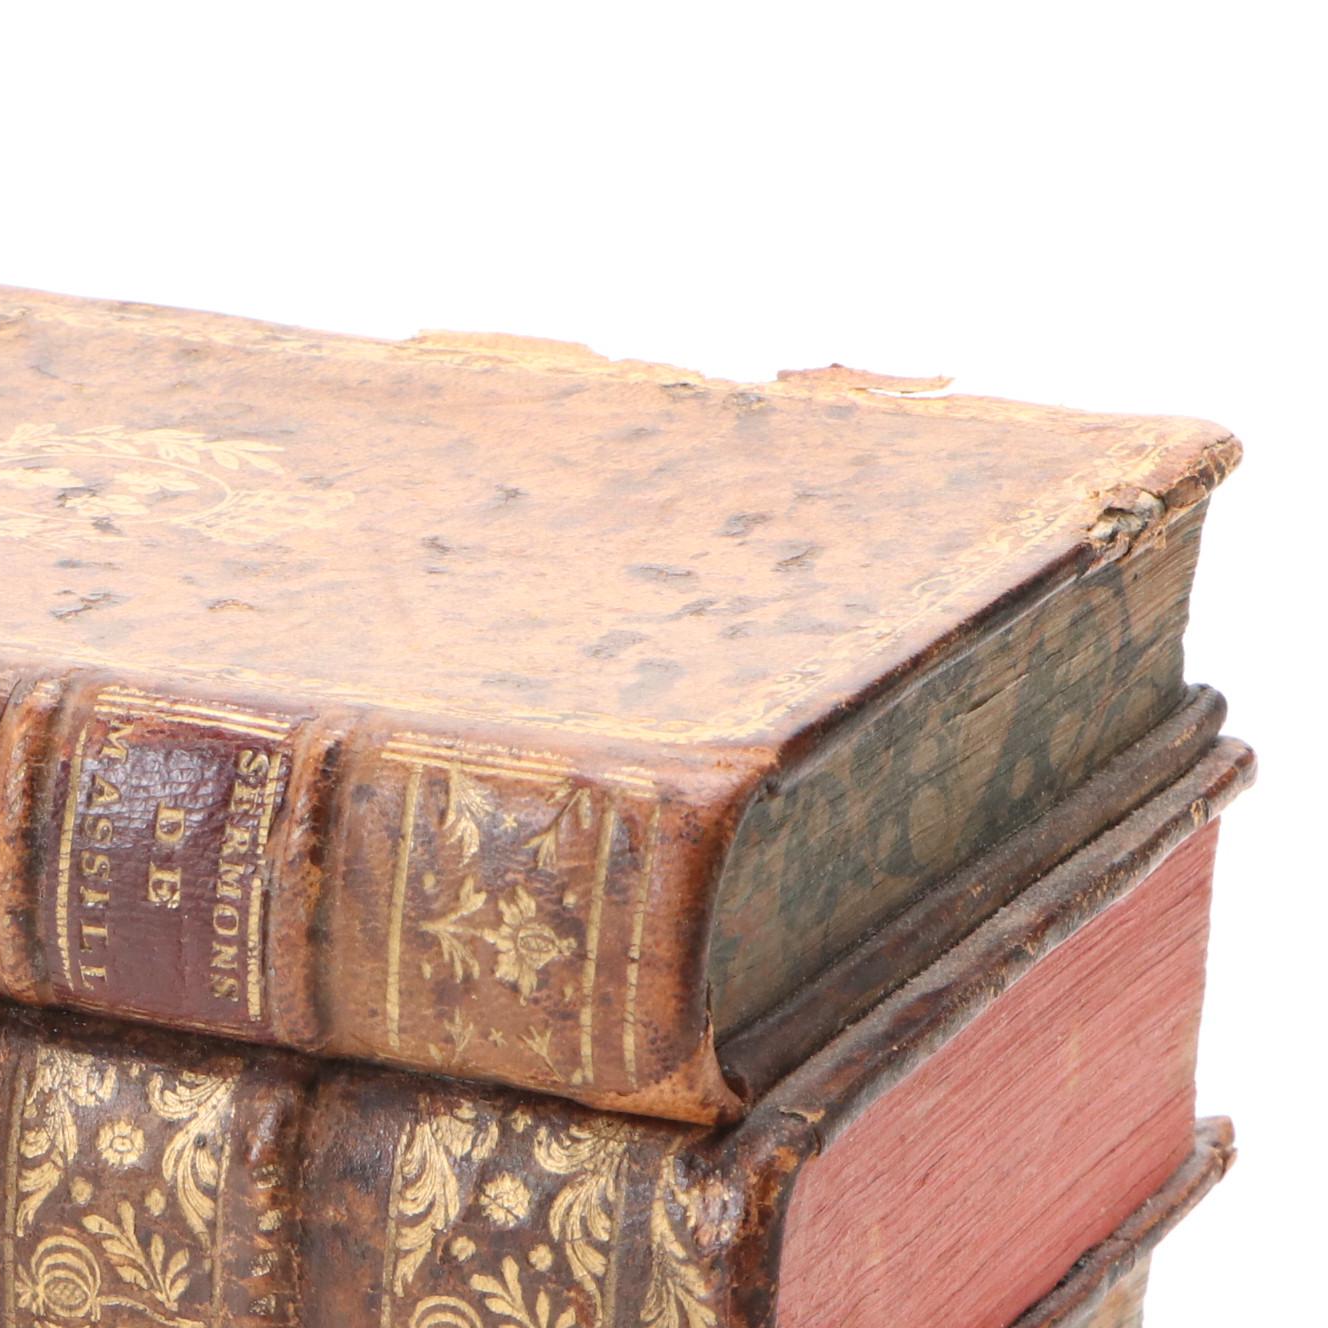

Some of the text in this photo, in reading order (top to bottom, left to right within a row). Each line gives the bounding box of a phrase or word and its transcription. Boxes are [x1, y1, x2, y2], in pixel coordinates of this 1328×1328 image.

[79, 719, 134, 991] MASSILL
[148, 802, 186, 909] DE
[212, 749, 272, 1002] SERMONS
